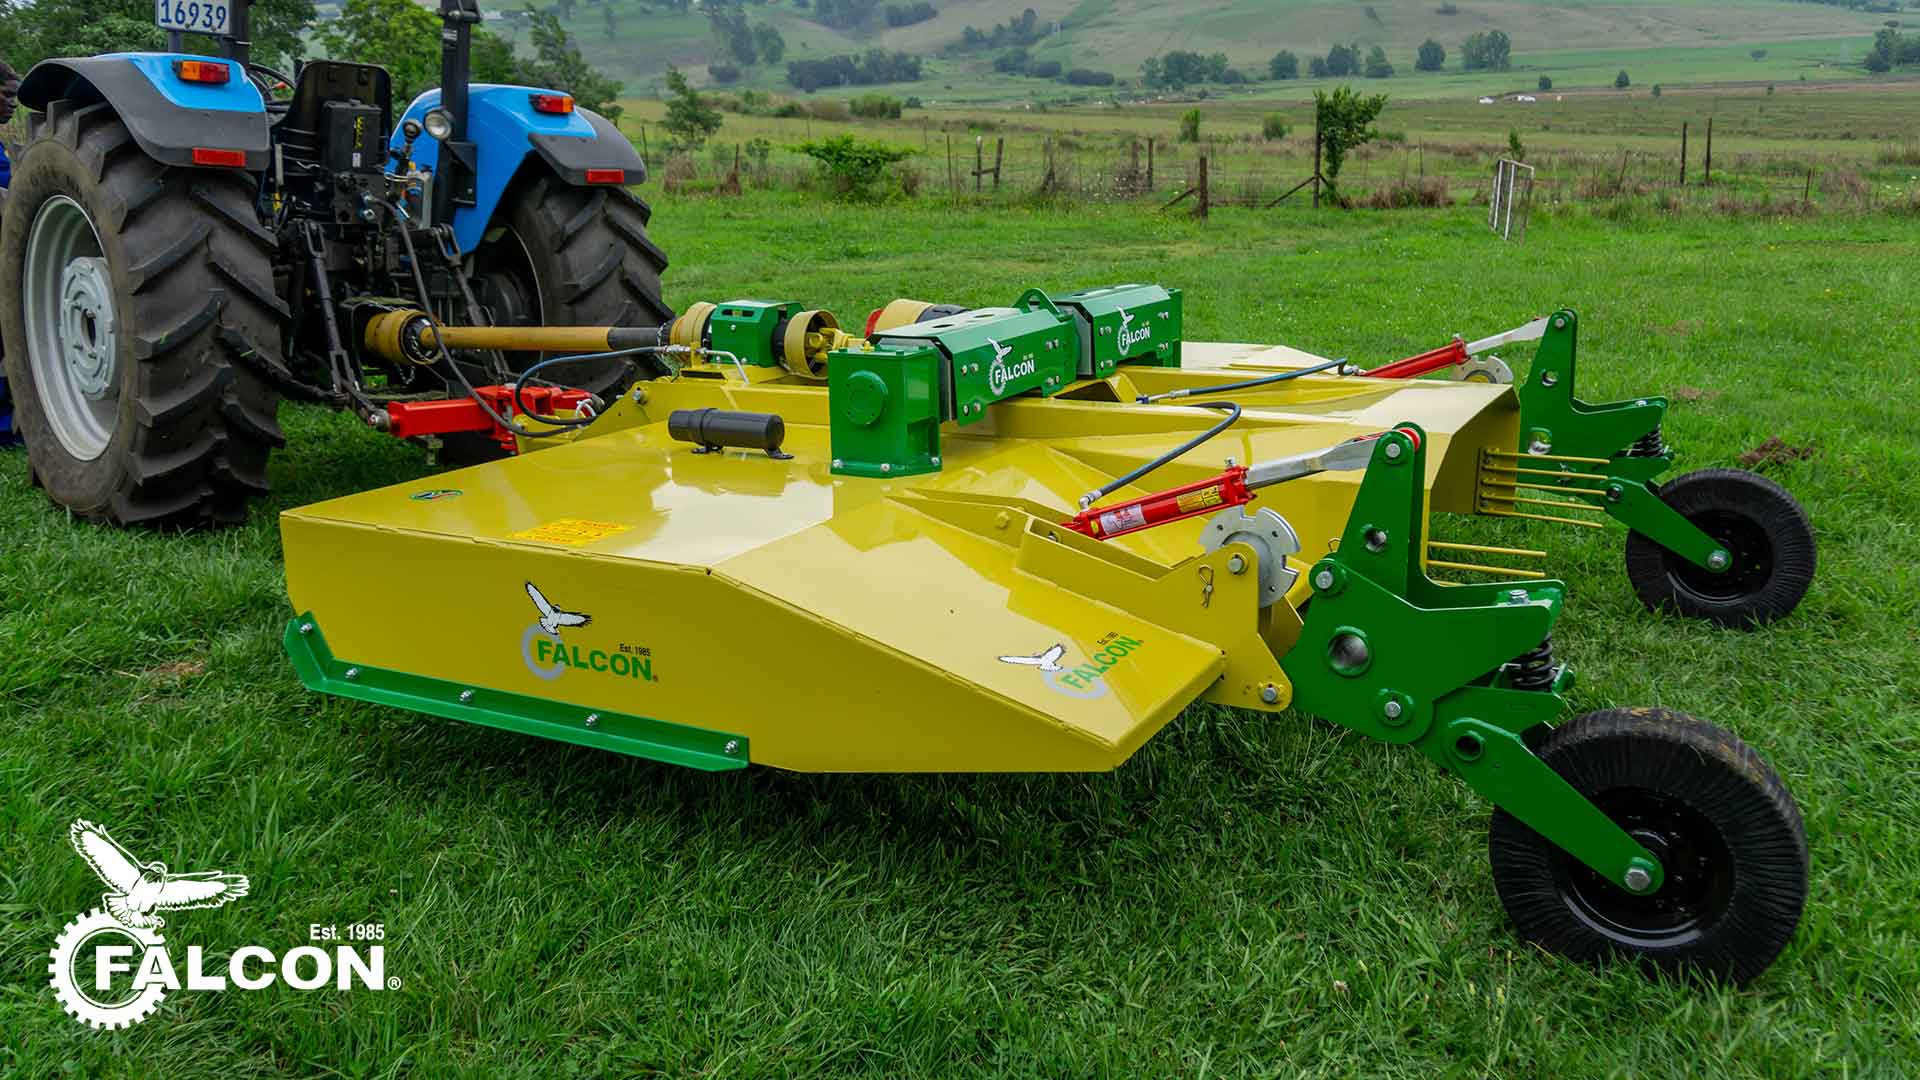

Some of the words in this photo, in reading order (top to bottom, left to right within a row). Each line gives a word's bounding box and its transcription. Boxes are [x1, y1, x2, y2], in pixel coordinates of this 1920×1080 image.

[160, 0, 226, 29] 16939
[1121, 326, 1151, 346] FALCON
[995, 359, 1035, 384] FALCON
[537, 639, 652, 681] FALCON
[1061, 635, 1143, 689] FALCON
